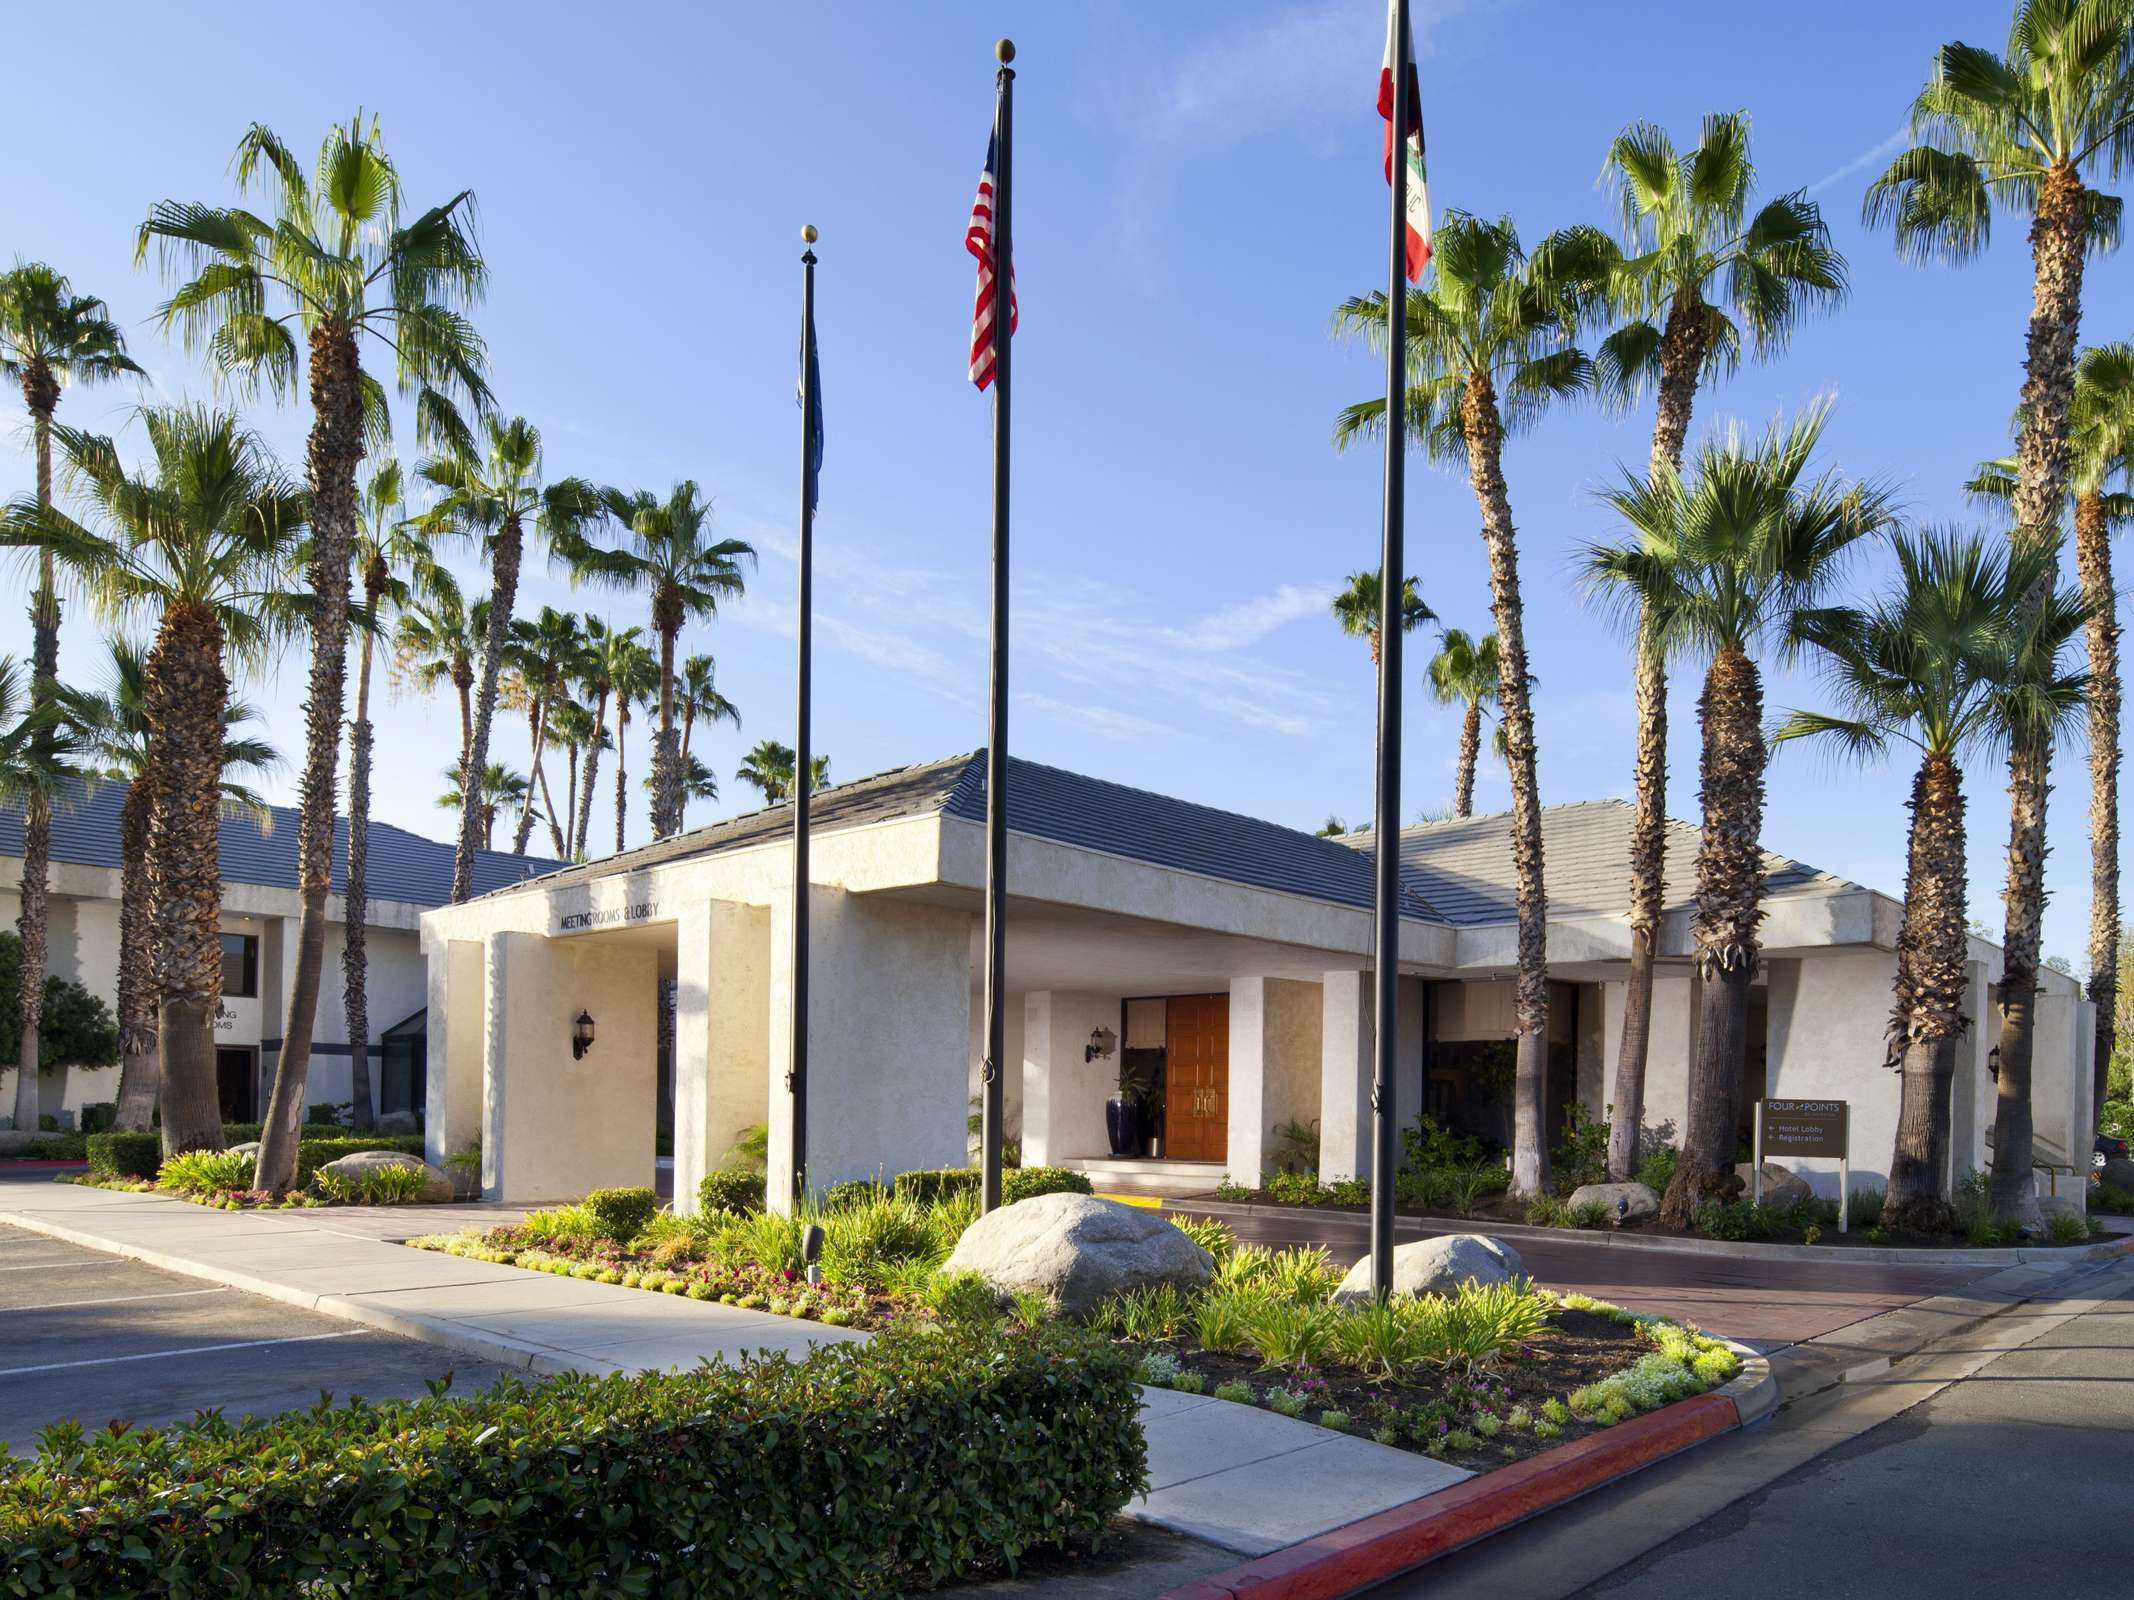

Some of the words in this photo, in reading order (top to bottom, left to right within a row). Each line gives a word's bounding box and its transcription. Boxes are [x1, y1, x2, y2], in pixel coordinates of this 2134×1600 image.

[560, 912, 592, 930] MEETING
[592, 908, 620, 924] ROOMS
[631, 903, 659, 919] LOBBY
[1768, 1102, 1795, 1111] FOUR
[1804, 1103, 1840, 1112] POINTS
[1801, 1126, 1824, 1134] Lobby
[1779, 1134, 1824, 1143] Registration
